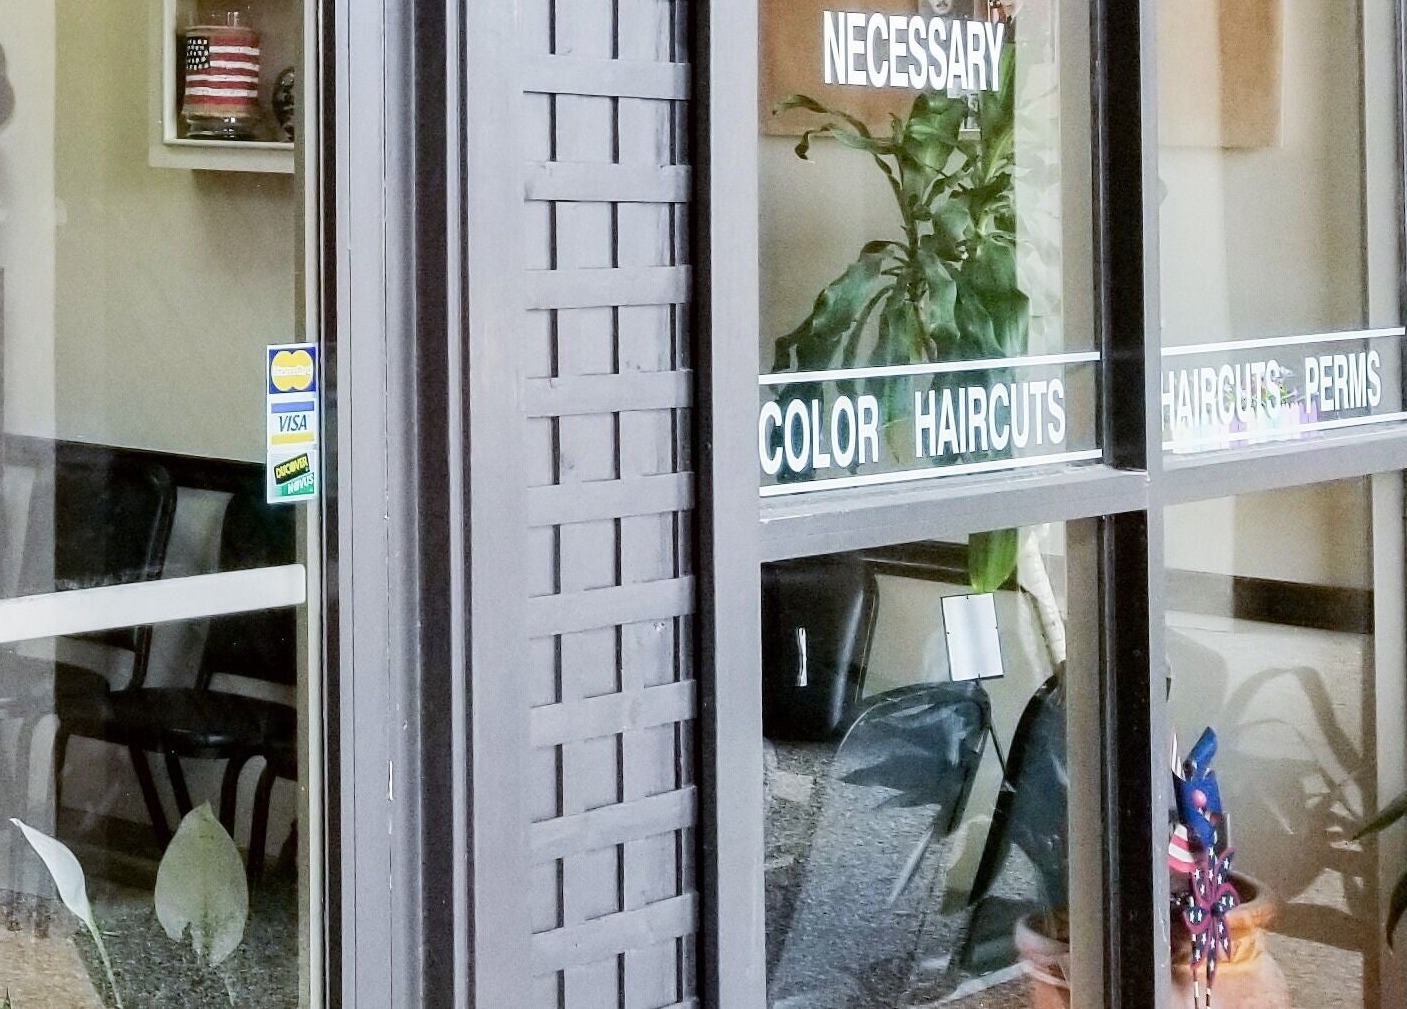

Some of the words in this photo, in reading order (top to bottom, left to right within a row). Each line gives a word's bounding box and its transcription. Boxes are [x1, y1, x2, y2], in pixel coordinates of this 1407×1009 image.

[822, 10, 1005, 92] NECESSARY
[279, 413, 308, 433] VISA
[759, 394, 879, 475] COLOR
[914, 377, 1066, 460] HAIRCUTS
[1160, 359, 1283, 432] HAIRCUTS
[1304, 349, 1382, 414] PERMS
